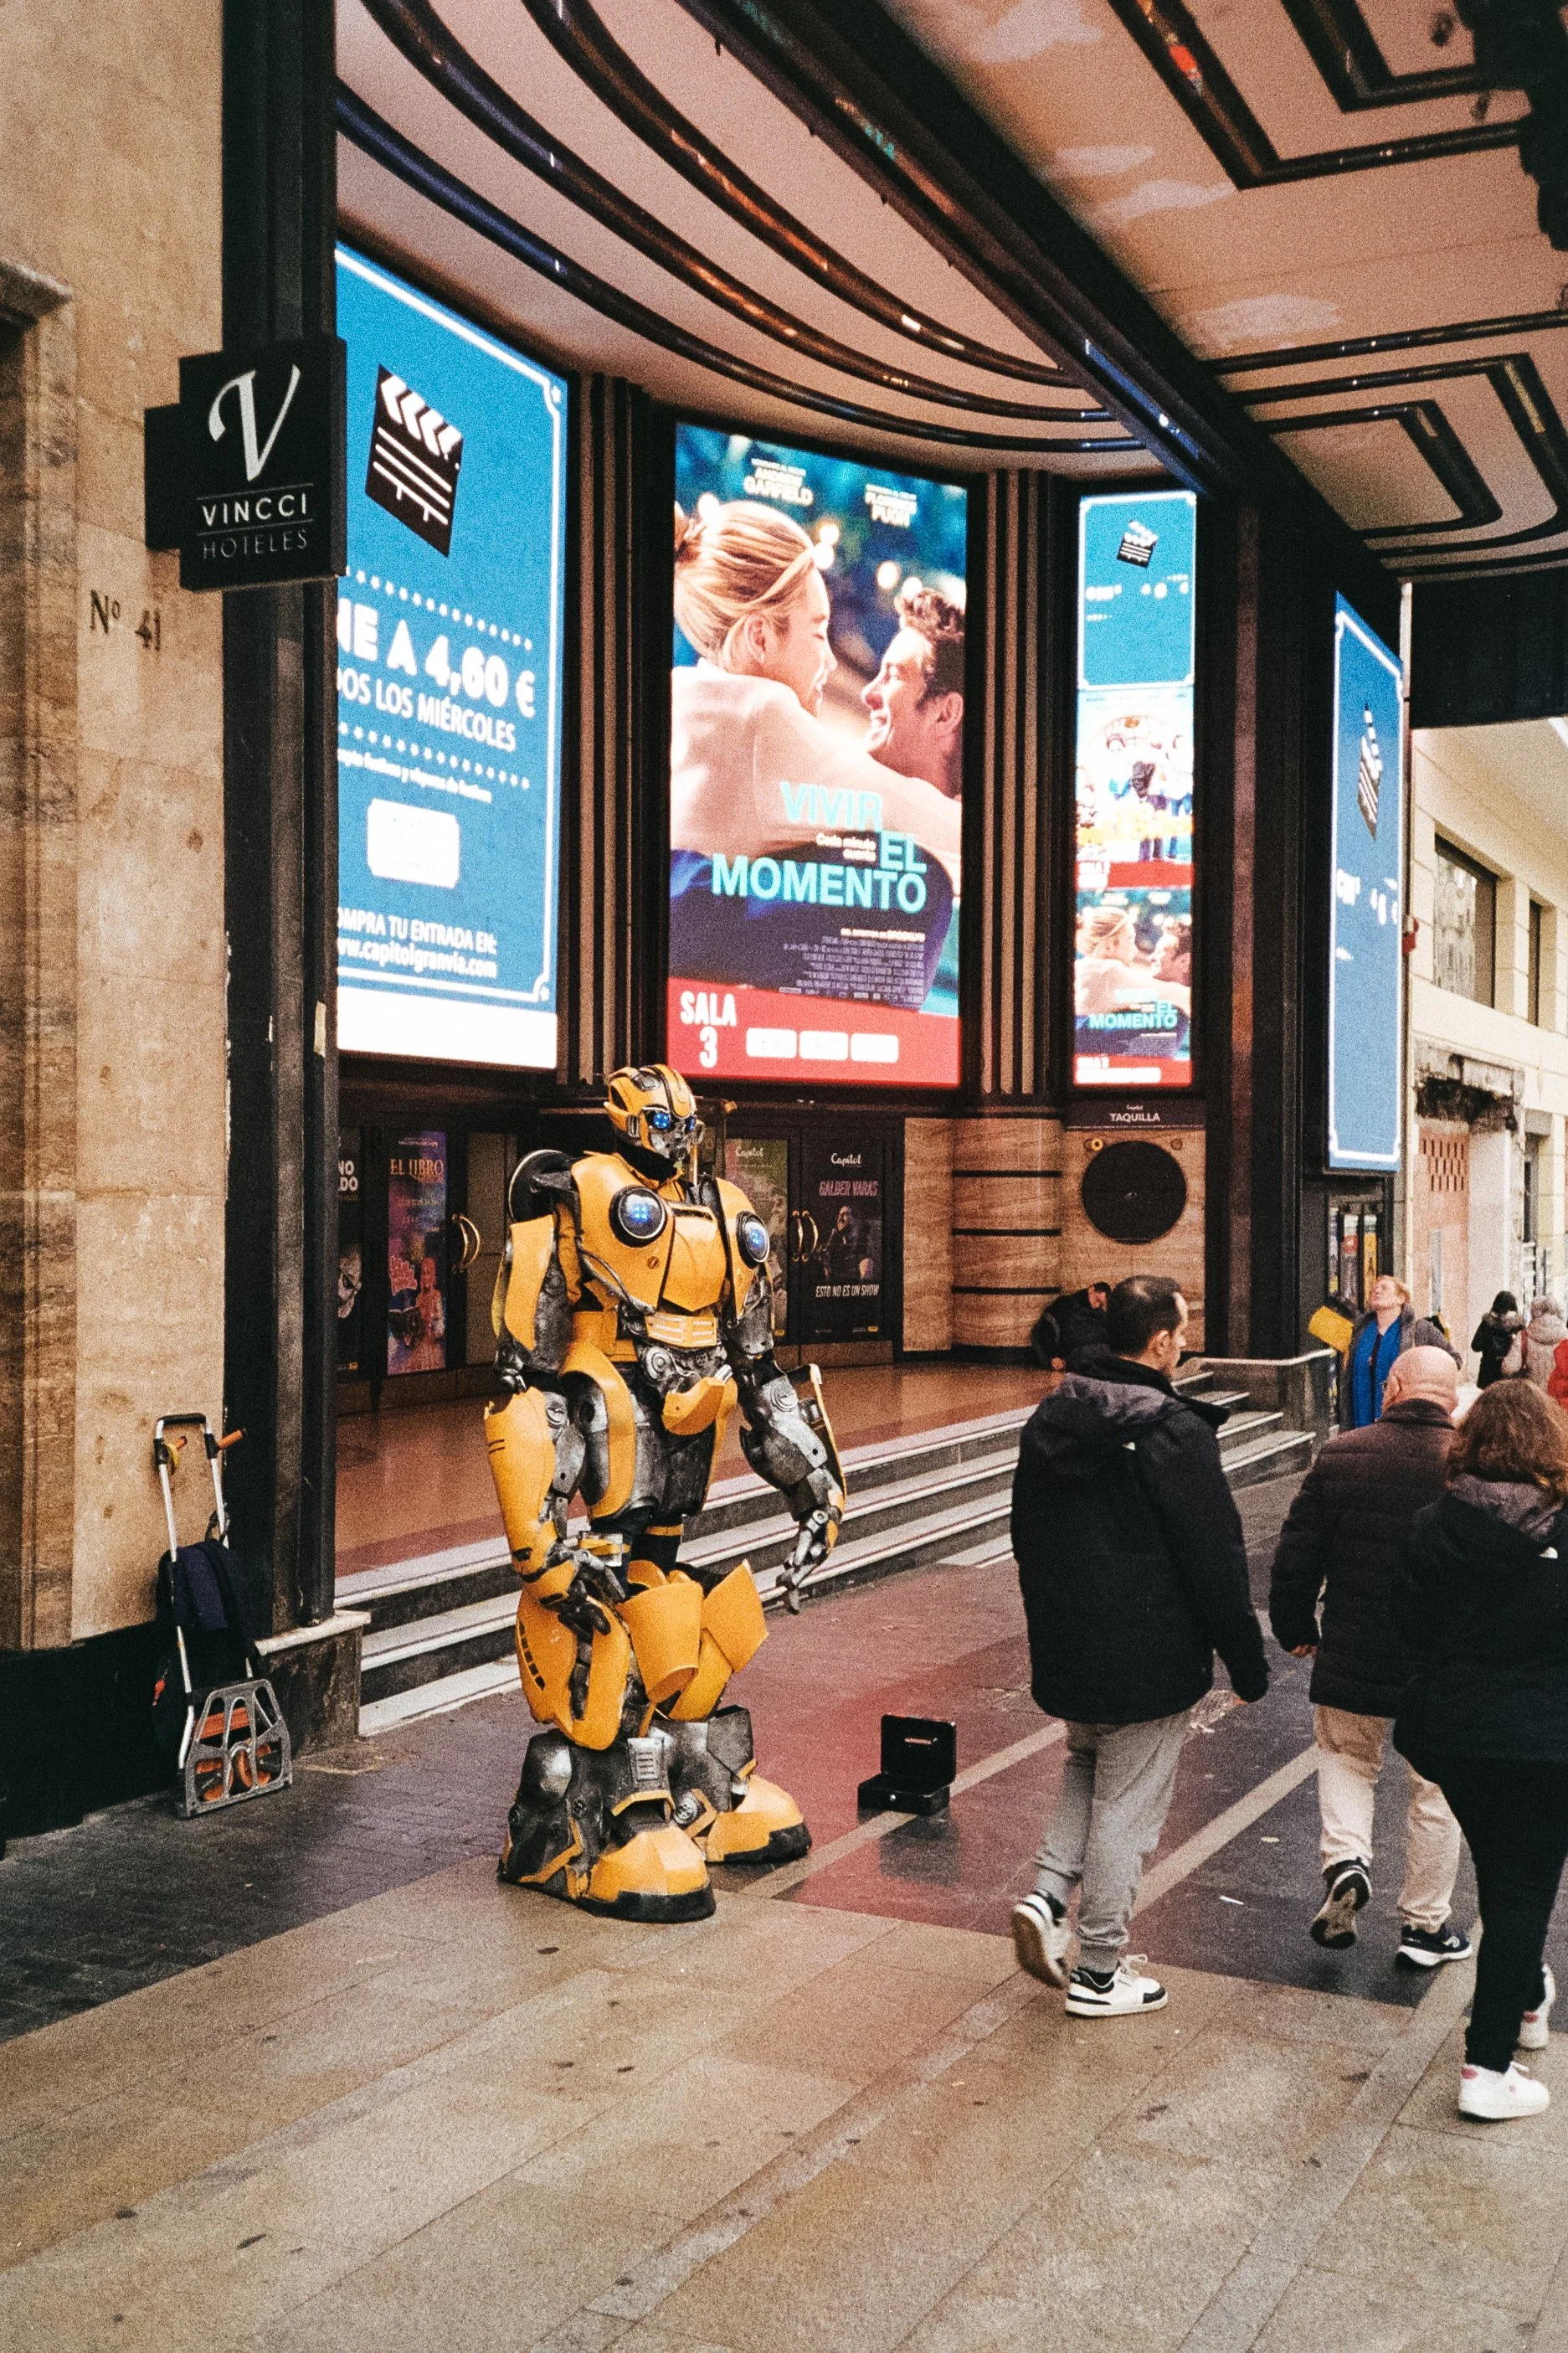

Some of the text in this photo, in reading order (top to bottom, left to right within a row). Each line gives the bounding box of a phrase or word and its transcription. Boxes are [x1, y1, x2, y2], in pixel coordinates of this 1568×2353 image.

[202, 492, 307, 526] VINCCI
[203, 529, 308, 559] HOTELES
[135, 610, 162, 651] 41
[387, 619, 418, 676] A
[424, 635, 508, 708] 4,60
[516, 670, 536, 718] €
[376, 678, 414, 718] LOS
[418, 693, 517, 753] MIÉRCOLES
[779, 780, 884, 832] VIVIR
[881, 831, 928, 873] EL
[712, 852, 928, 914] MOMENTO
[388, 915, 409, 940] TU
[411, 919, 474, 951] ENTRADA
[680, 991, 738, 1027] SALA
[1088, 1012, 1178, 1030] MOMENTO
[699, 1026, 718, 1068] 3
[1109, 1113, 1161, 1123] TAQUILLA
[389, 1158, 445, 1180] EL LIBRO
[830, 1152, 862, 1167] Capitol
[337, 1176, 359, 1192] DO
[815, 1285, 880, 1298] ESTO NO ES UN SHOW
